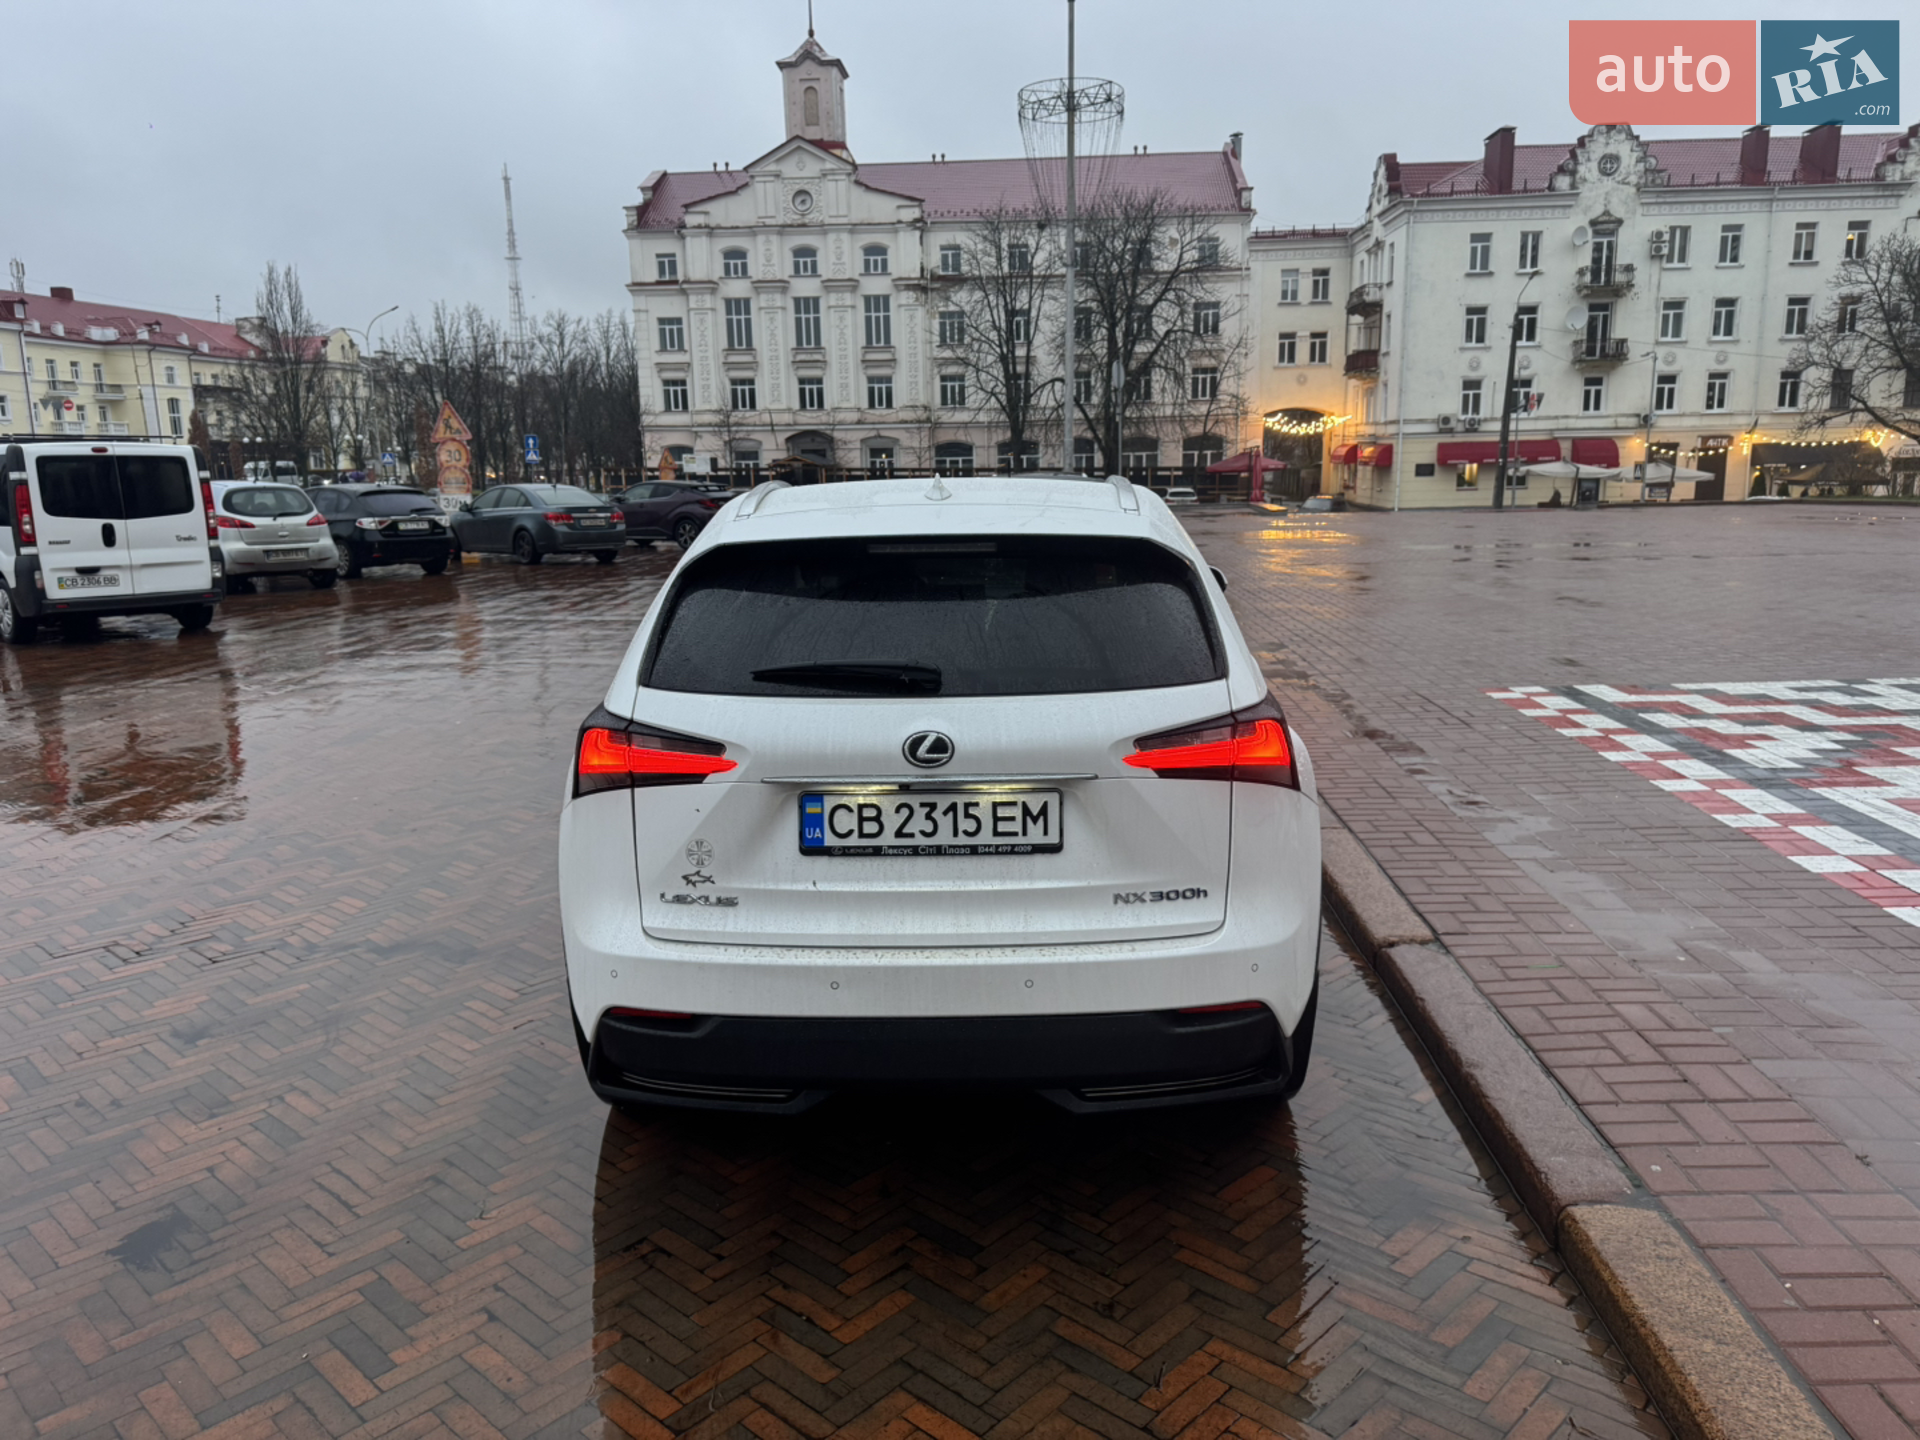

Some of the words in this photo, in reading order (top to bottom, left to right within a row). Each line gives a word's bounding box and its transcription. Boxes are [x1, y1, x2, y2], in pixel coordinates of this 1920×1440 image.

[445, 449, 462, 463] 30
[828, 802, 885, 839] CB
[894, 801, 982, 839] 2315
[992, 800, 1049, 838] EM
[805, 827, 823, 839] UA
[881, 846, 914, 855] Лексус
[941, 845, 971, 854] Плаза
[659, 892, 740, 907] LEXUS
